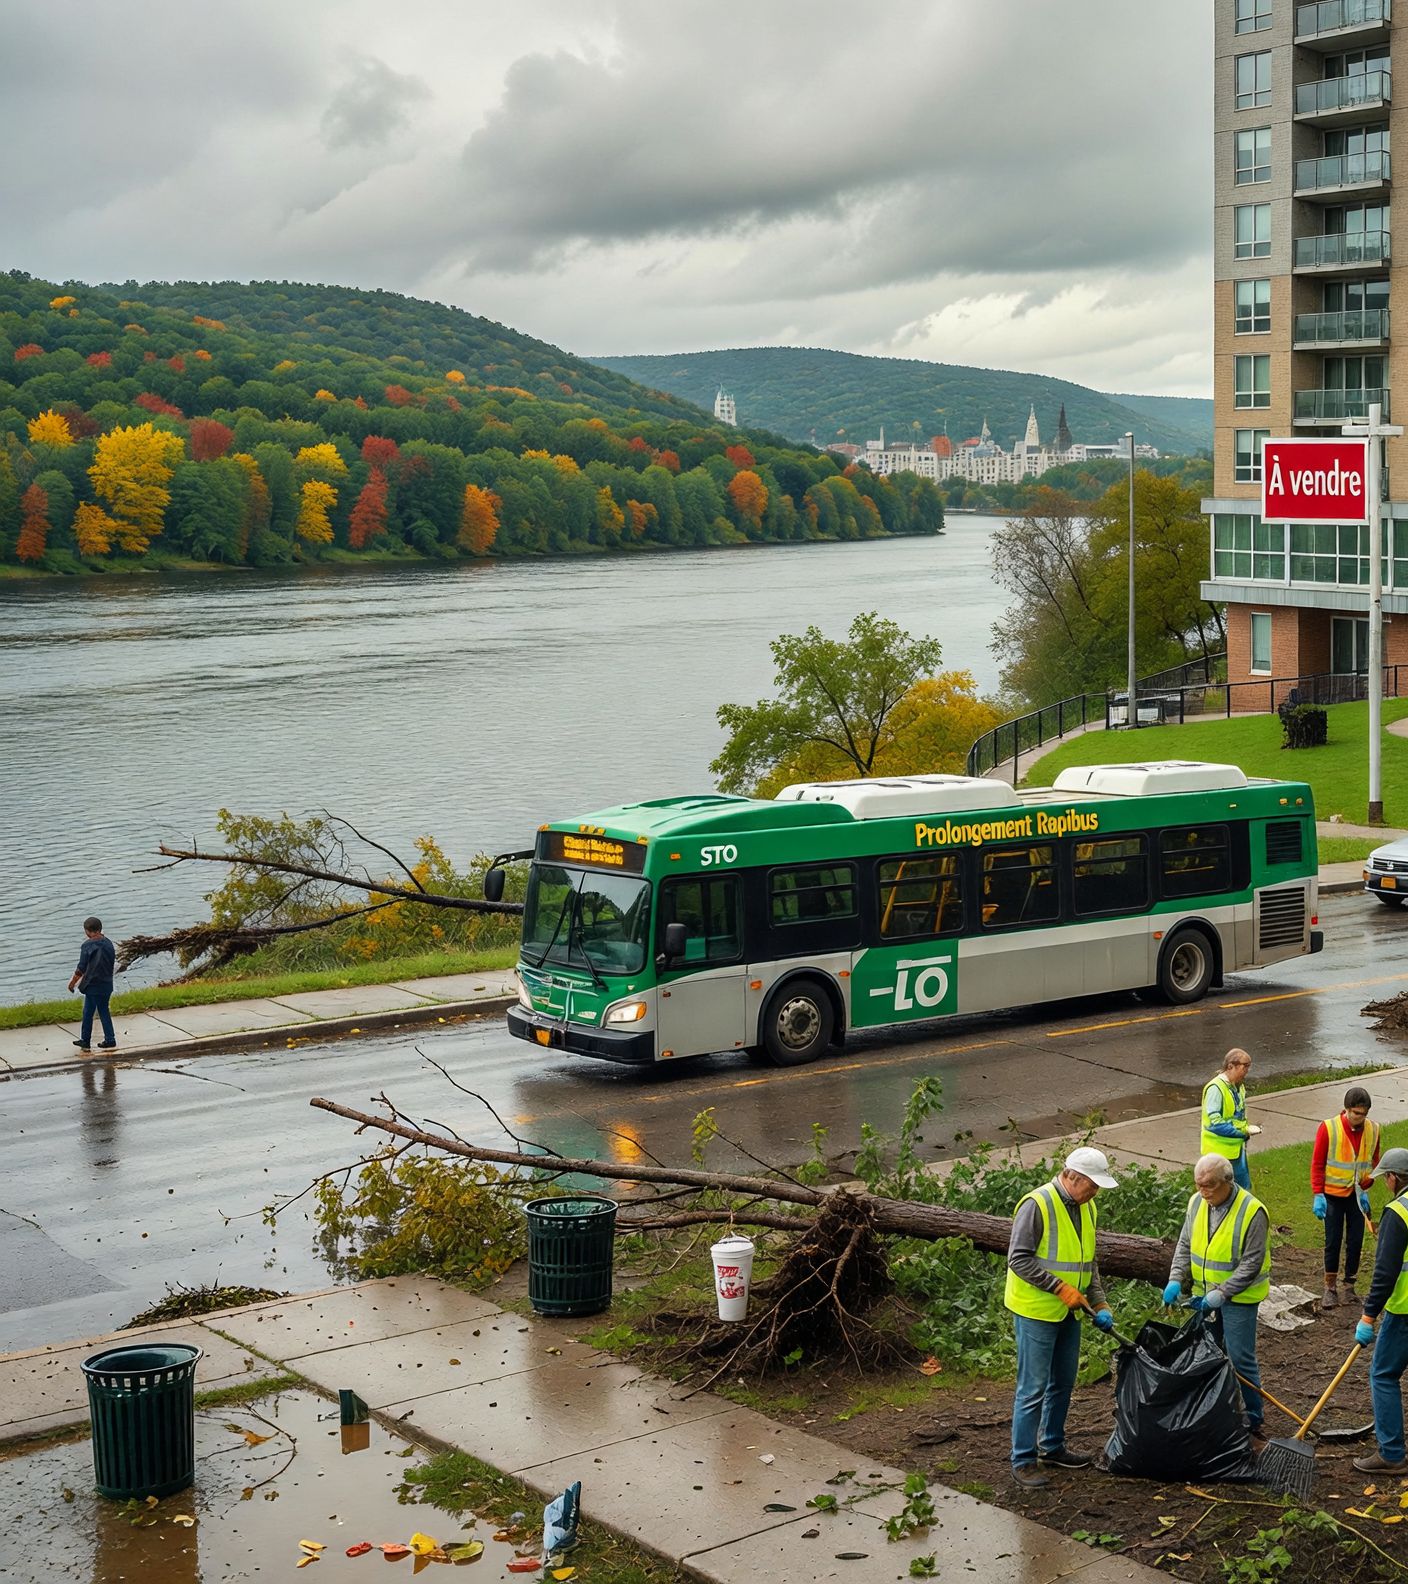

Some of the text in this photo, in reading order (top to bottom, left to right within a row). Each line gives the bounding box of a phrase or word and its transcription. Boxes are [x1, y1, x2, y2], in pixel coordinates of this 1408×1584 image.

[1268, 454, 1362, 496] À vendre
[915, 808, 1099, 847] Prolongement Rapibus
[700, 844, 738, 866] STO
